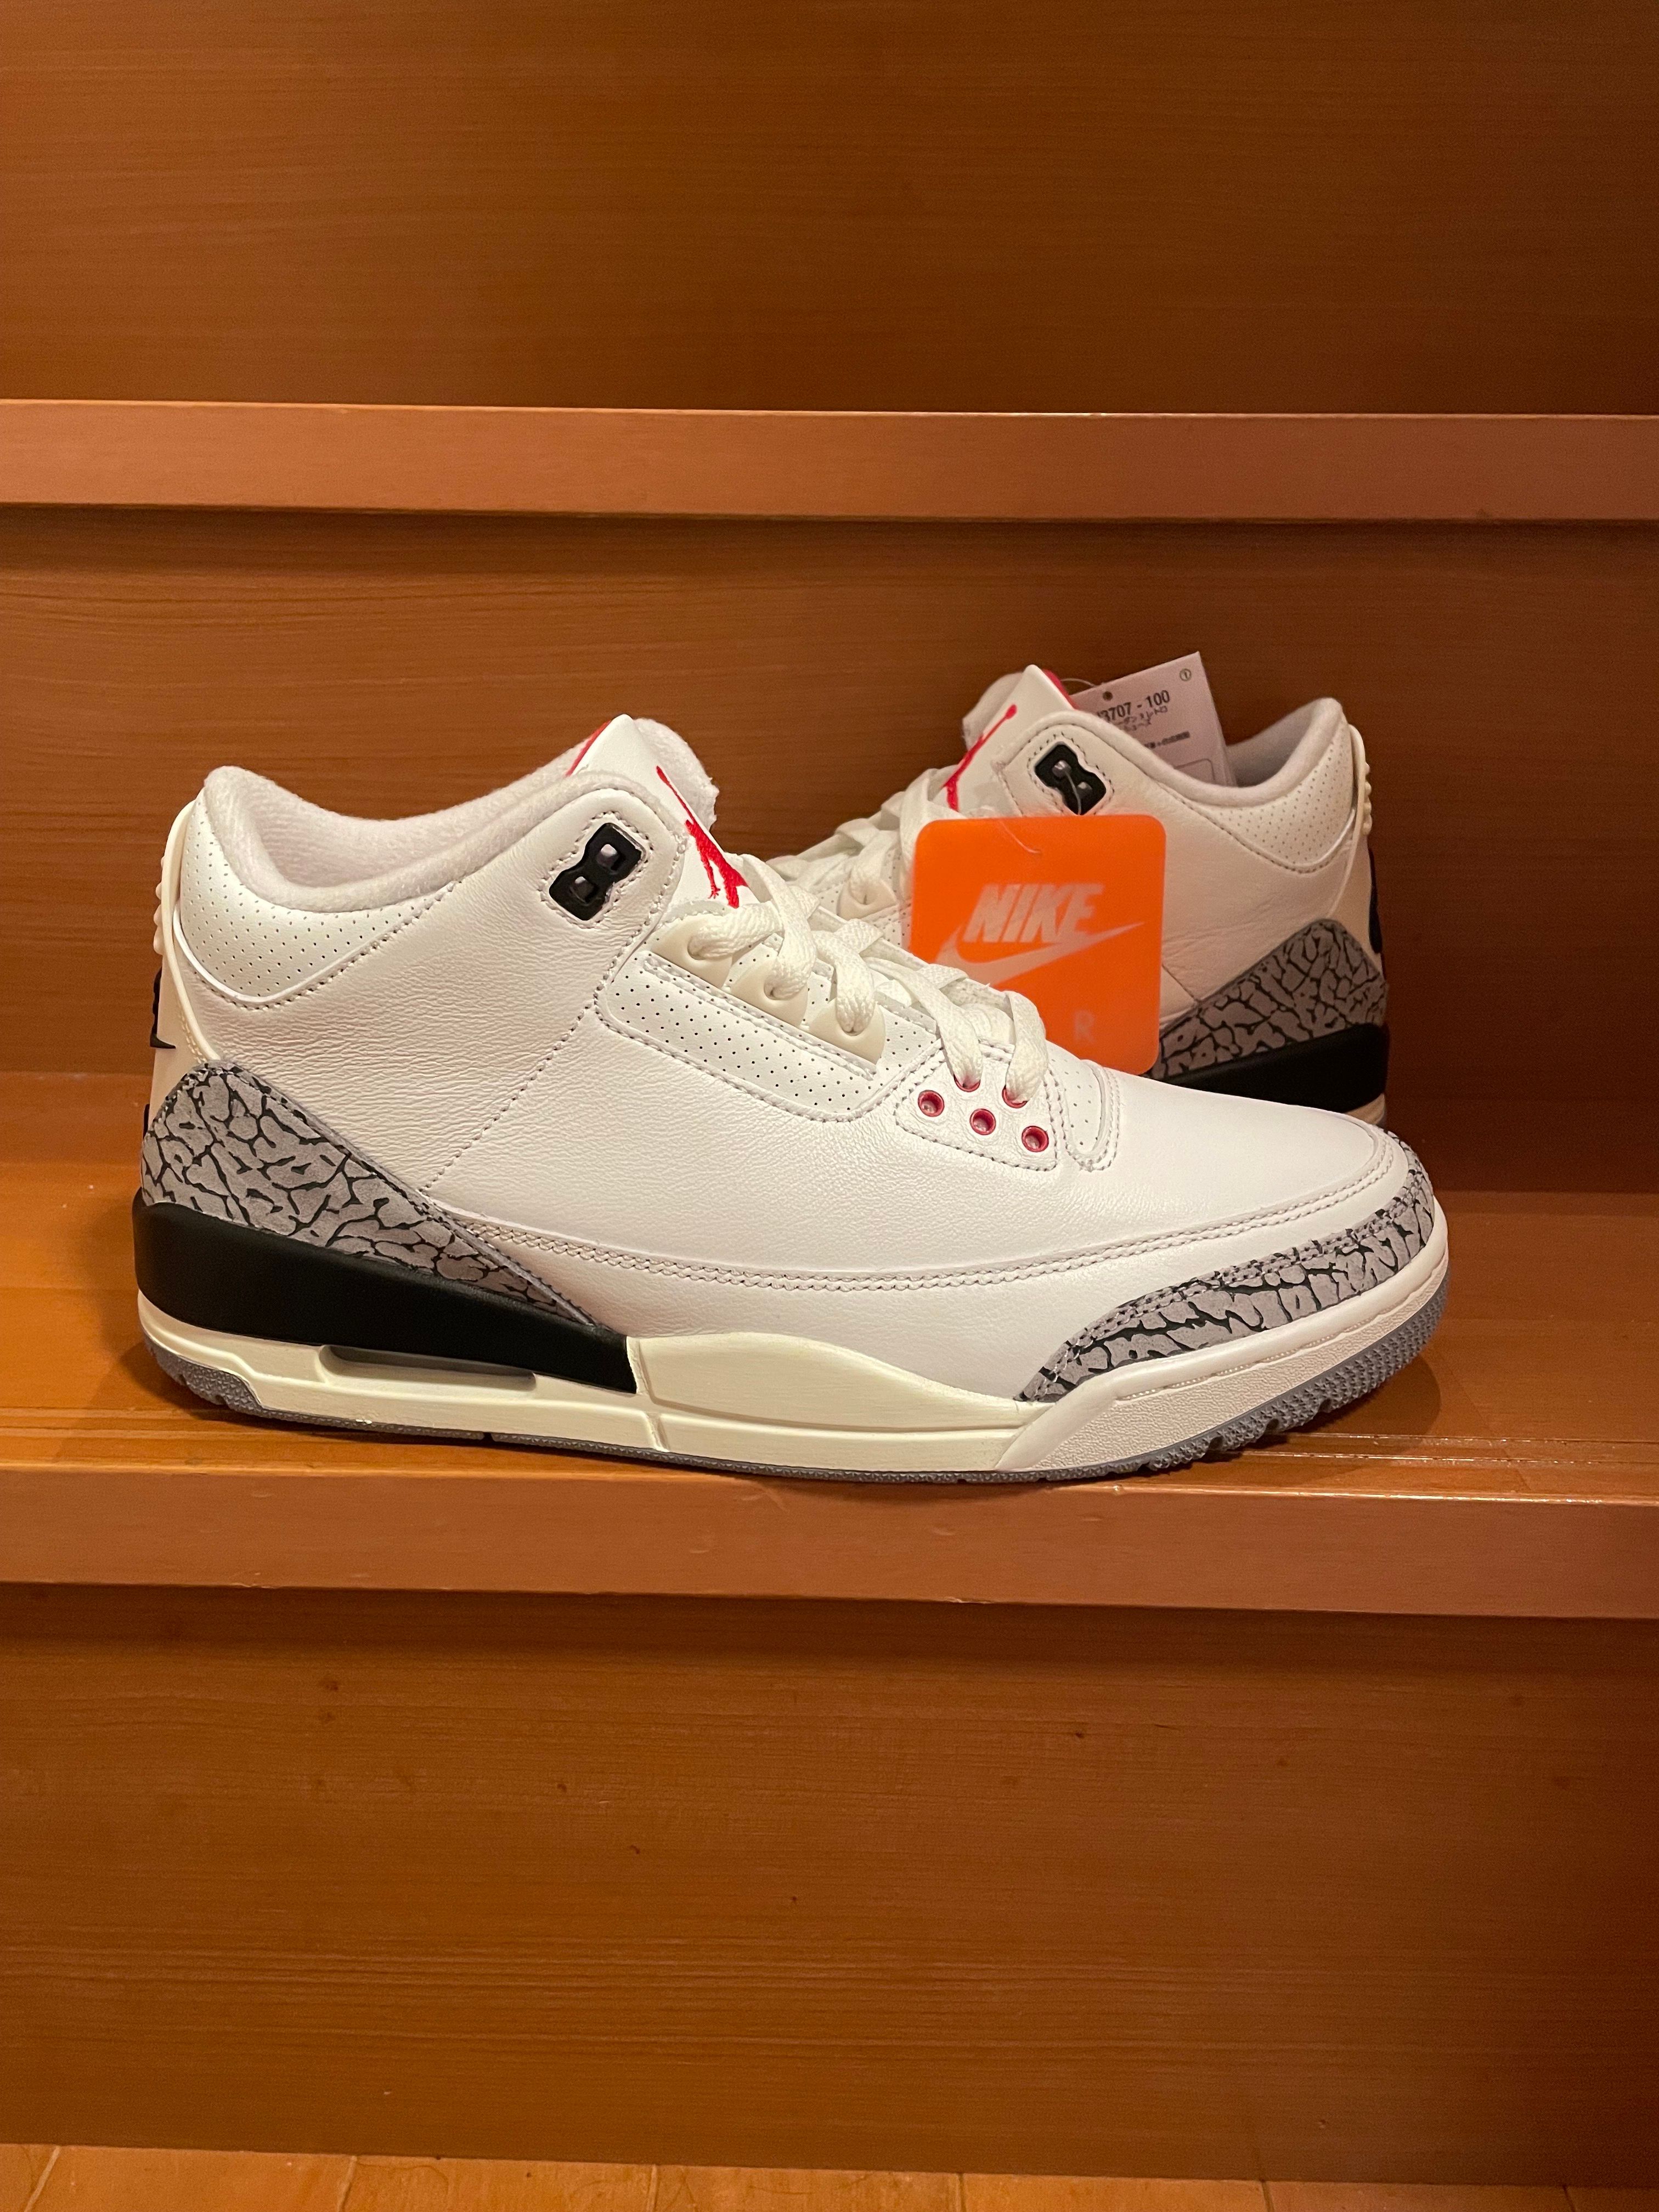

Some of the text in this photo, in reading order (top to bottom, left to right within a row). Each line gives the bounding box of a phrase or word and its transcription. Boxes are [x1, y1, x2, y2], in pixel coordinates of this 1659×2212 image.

[1097, 702, 1131, 722] 3707
[1146, 690, 1170, 708] 100
[962, 883, 1104, 943] NIKE
